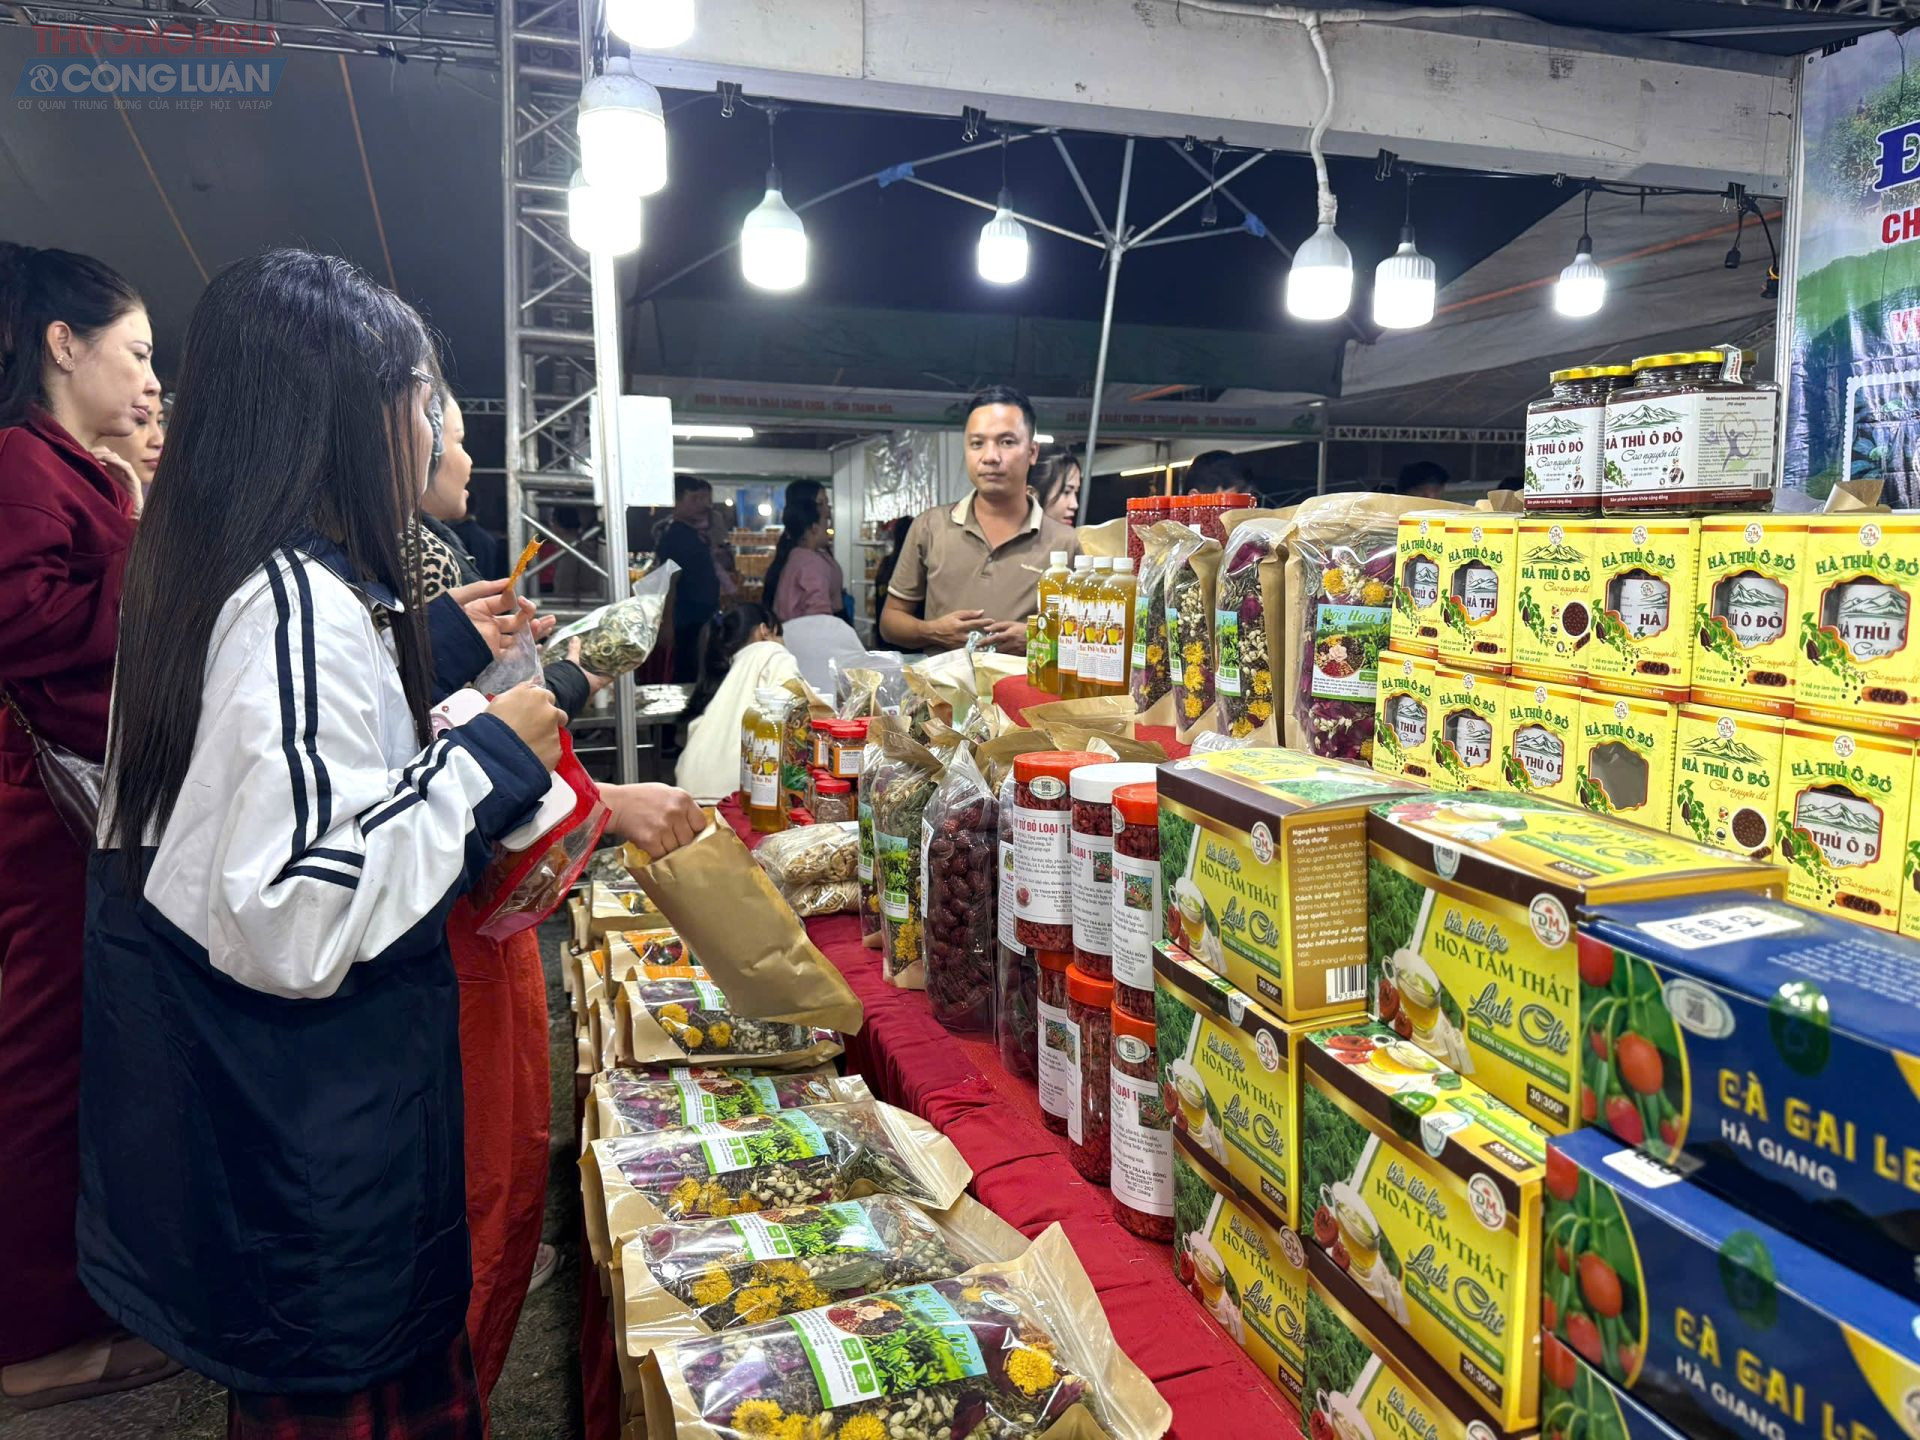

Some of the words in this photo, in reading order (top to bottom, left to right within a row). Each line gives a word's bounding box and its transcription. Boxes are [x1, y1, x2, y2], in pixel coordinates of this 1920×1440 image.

[1537, 440, 1555, 454] THỦ
[1559, 440, 1566, 454] Ô
[1569, 437, 1584, 453] ĐỎ
[1622, 430, 1645, 449] THỦ
[1650, 432, 1659, 445] Ô
[1663, 426, 1683, 444] ĐỎ
[1621, 449, 1642, 463] Cao
[1449, 548, 1461, 562] HÀ
[1462, 545, 1479, 558] THỦ
[1481, 547, 1488, 558] Ô
[1491, 551, 1503, 563] ĐỎ
[1708, 552, 1726, 569] HÀ
[1730, 547, 1755, 563] THỦ
[1759, 550, 1770, 565] Ô
[1774, 553, 1796, 570] ĐỎ
[1816, 556, 1837, 575] HÀ
[1841, 551, 1873, 568] THỦ
[1877, 553, 1891, 569] Ô
[1894, 558, 1919, 576] ĐỎ
[1349, 609, 1375, 622] Hoa
[1640, 612, 1661, 626] HÀ
[1741, 612, 1751, 627] Ô
[1757, 612, 1782, 628] ĐỎ
[1854, 622, 1890, 641] THỦ
[1853, 641, 1884, 656] Cao
[1382, 677, 1394, 689] HÀ
[1394, 676, 1409, 689] THỦ
[1411, 679, 1418, 690] Ô
[1419, 683, 1431, 697] ĐỎ
[1400, 719, 1416, 733] THỦ
[1466, 744, 1480, 757] HÀ
[1525, 753, 1543, 770] THỦ
[1547, 759, 1554, 772] Ô
[1709, 780, 1729, 793] Cao
[1730, 787, 1755, 800] nguyên
[1026, 819, 1037, 832] ĐỎ
[1039, 822, 1058, 836] LOẠI
[1061, 824, 1066, 834] 1
[1293, 828, 1316, 837] Nguyên
[1293, 835, 1310, 846] Công
[1311, 833, 1329, 845] dụng:
[1812, 830, 1841, 850] THỦ
[1847, 835, 1859, 853] Ô
[1087, 849, 1092, 860] 1
[1201, 860, 1221, 885] HOA
[1221, 869, 1246, 895] TAM
[1296, 894, 1312, 902] Cách
[1221, 897, 1245, 935] Linh
[1249, 910, 1279, 948] Chi
[1296, 911, 1308, 921] Bảo
[1319, 928, 1339, 938] Không
[1297, 939, 1314, 949] hoặc
[1315, 938, 1326, 947] hết
[1326, 937, 1339, 948] hạn
[1435, 932, 1471, 964] HOA
[1474, 949, 1515, 983] TAM
[1519, 967, 1573, 1007] THẤT
[1467, 982, 1512, 1029] Linh
[1519, 1004, 1571, 1054] Chi
[1202, 1048, 1224, 1075] HOA
[1225, 1063, 1250, 1092] TAM
[1132, 1090, 1137, 1101] 1
[1719, 1068, 1768, 1123] CÀ
[1784, 1097, 1856, 1163] GAI
[1721, 1117, 1752, 1150] HÀ
[1757, 1137, 1837, 1191] GIANG
[1376, 1178, 1410, 1219] HOA
[1413, 1212, 1451, 1251] TAM
[1456, 1238, 1509, 1291] THẤT
[1406, 1244, 1447, 1291] Linh
[1454, 1276, 1505, 1337] Chi
[947, 1331, 977, 1367] Trà
[1674, 1306, 1722, 1368] CÀ
[1736, 1348, 1805, 1425] GAI
[1676, 1355, 1707, 1393] HÀ
[1711, 1382, 1785, 1440] GIANG
[1376, 1399, 1409, 1440] HOA
